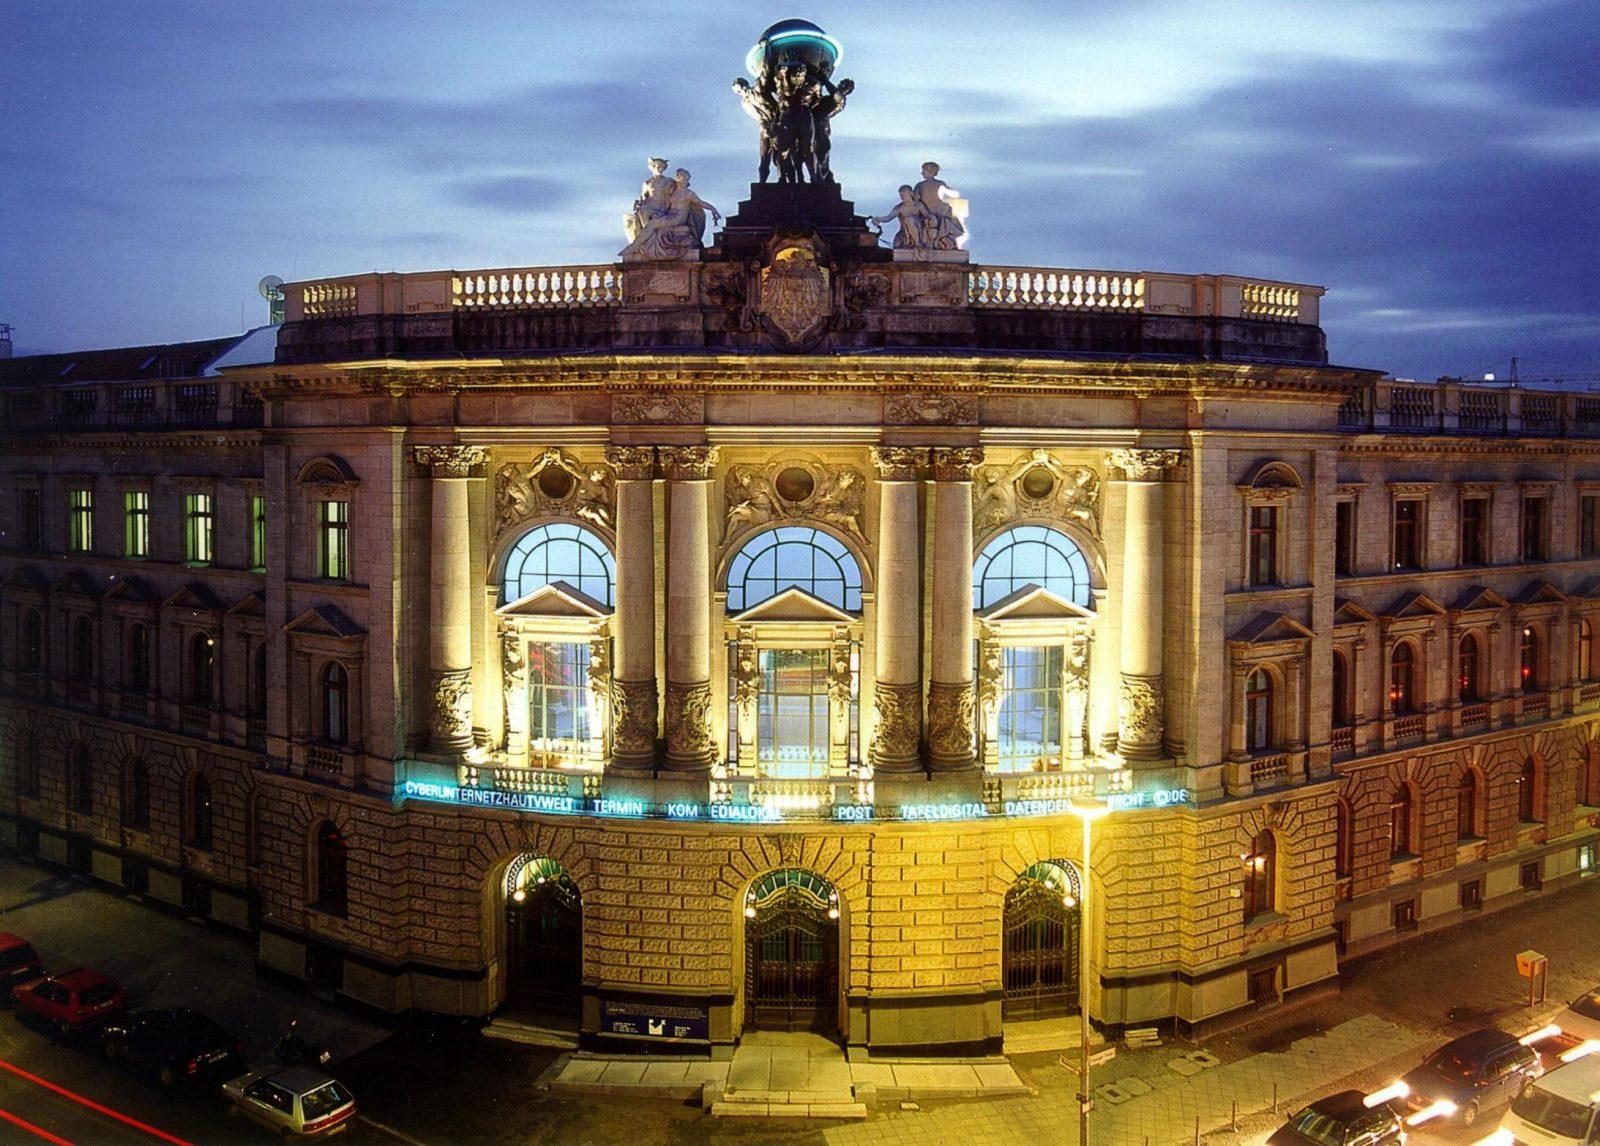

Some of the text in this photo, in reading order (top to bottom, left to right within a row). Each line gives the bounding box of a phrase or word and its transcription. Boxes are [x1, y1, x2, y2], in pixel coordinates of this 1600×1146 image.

[593, 799, 643, 815] TERMIN
[668, 803, 699, 817] KOM
[838, 806, 873, 820] POST
